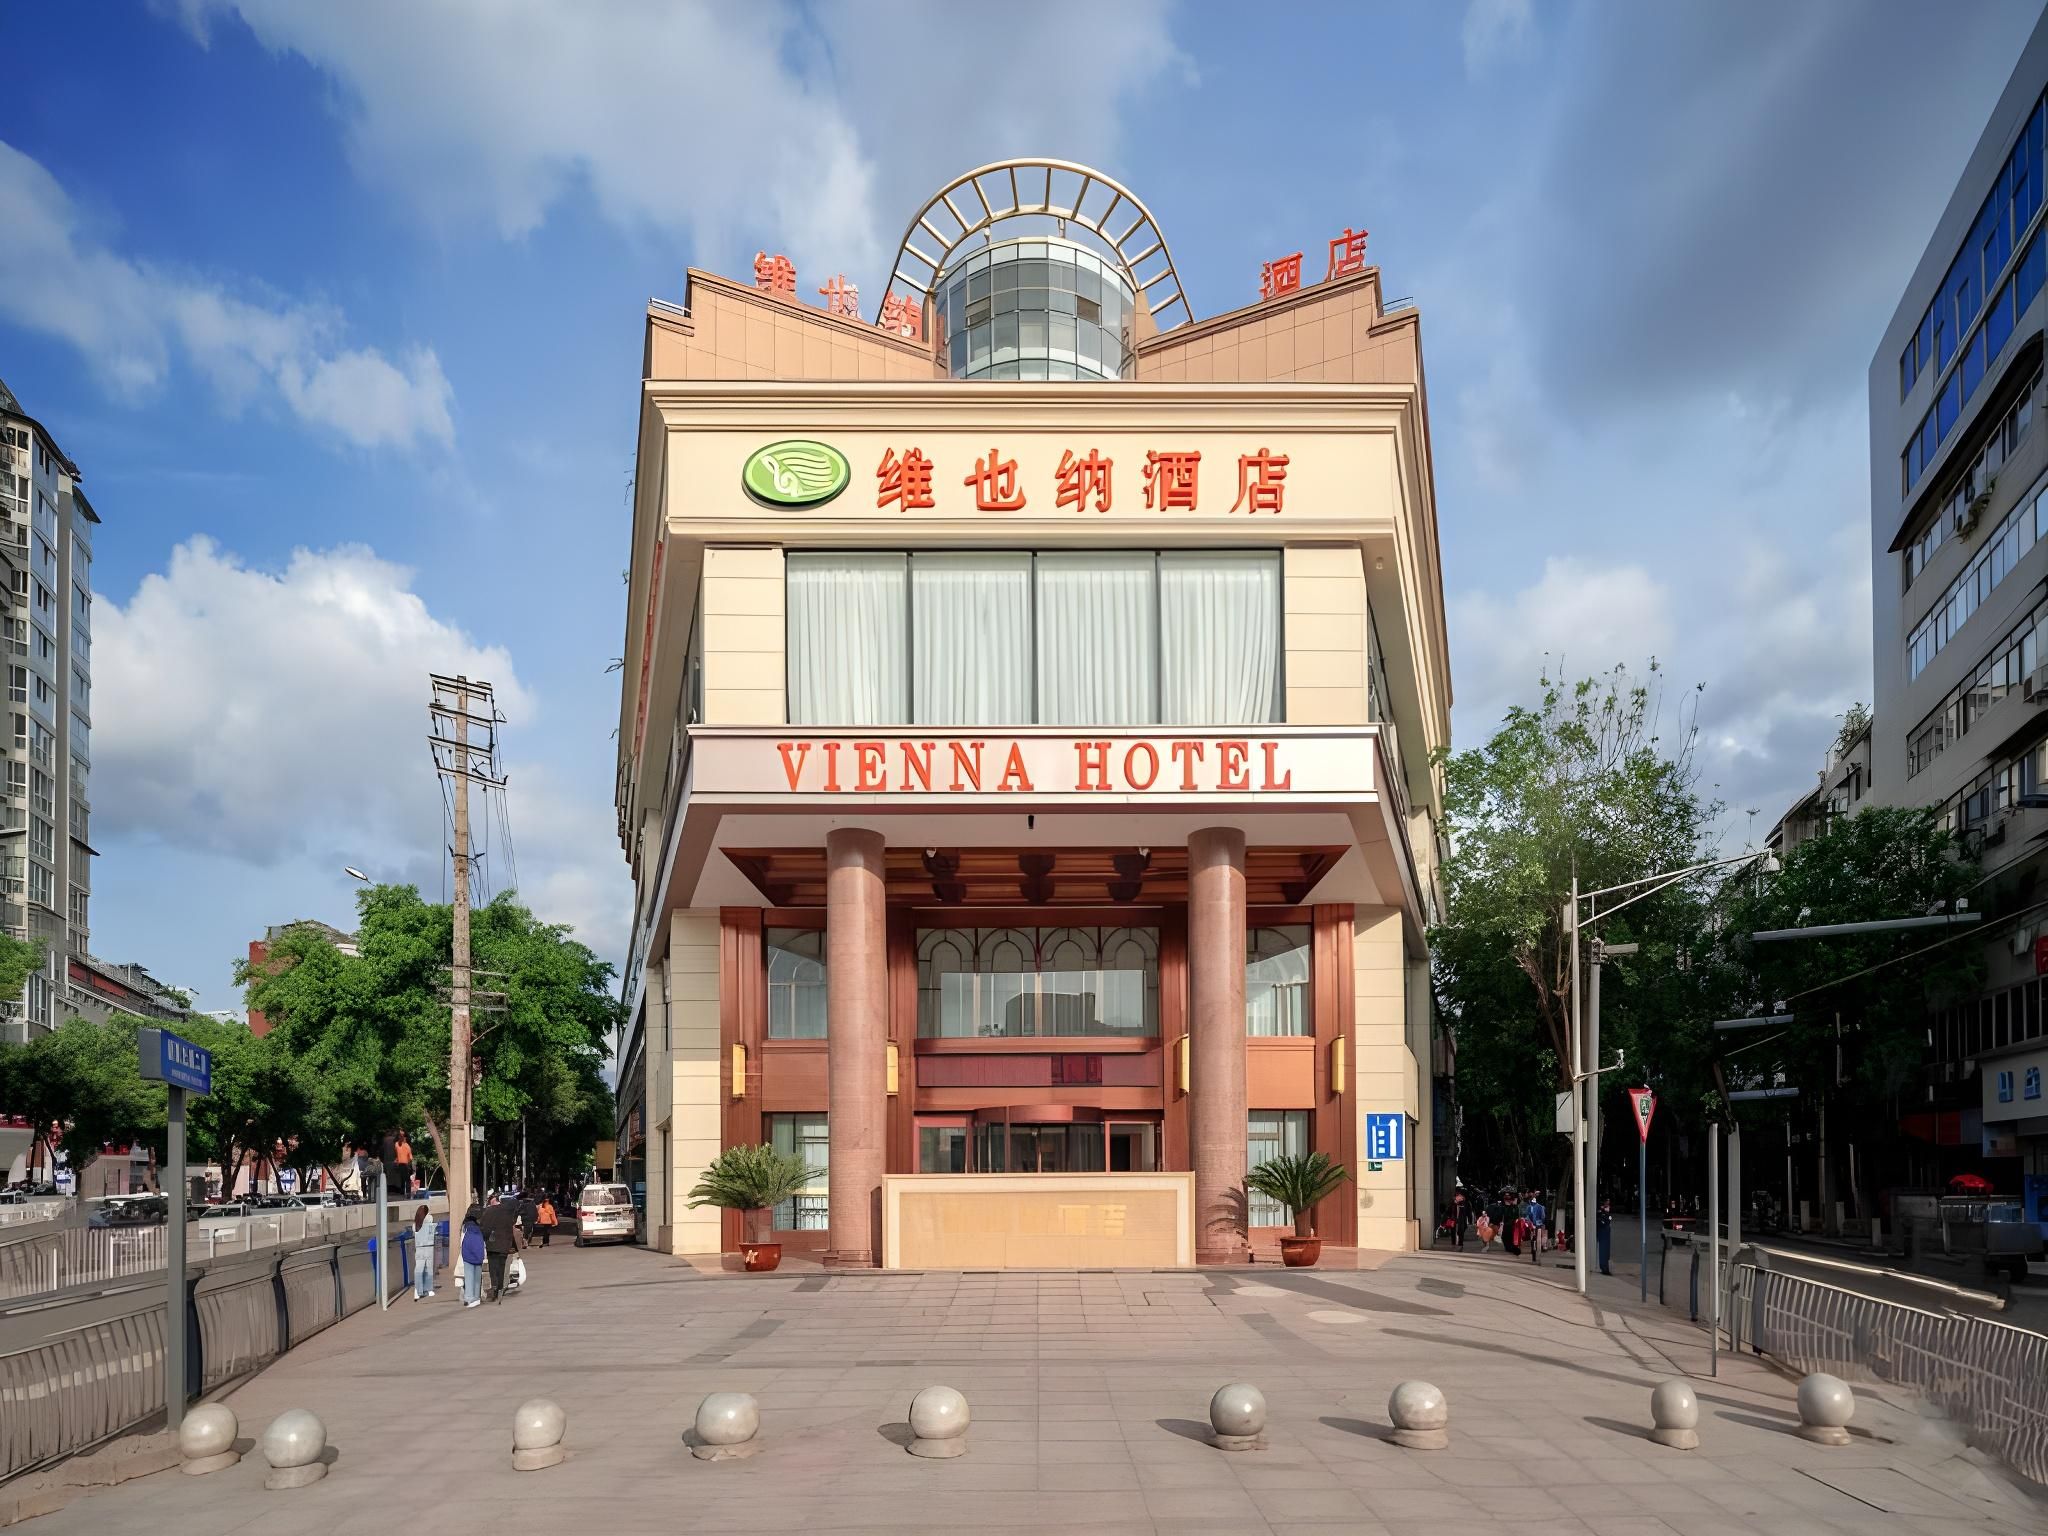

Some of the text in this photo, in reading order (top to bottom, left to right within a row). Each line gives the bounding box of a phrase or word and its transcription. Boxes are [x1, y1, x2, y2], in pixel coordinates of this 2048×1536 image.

[875, 447, 1290, 513] 维也纳酒店
[777, 740, 1291, 793] VIENNA HOTEL
